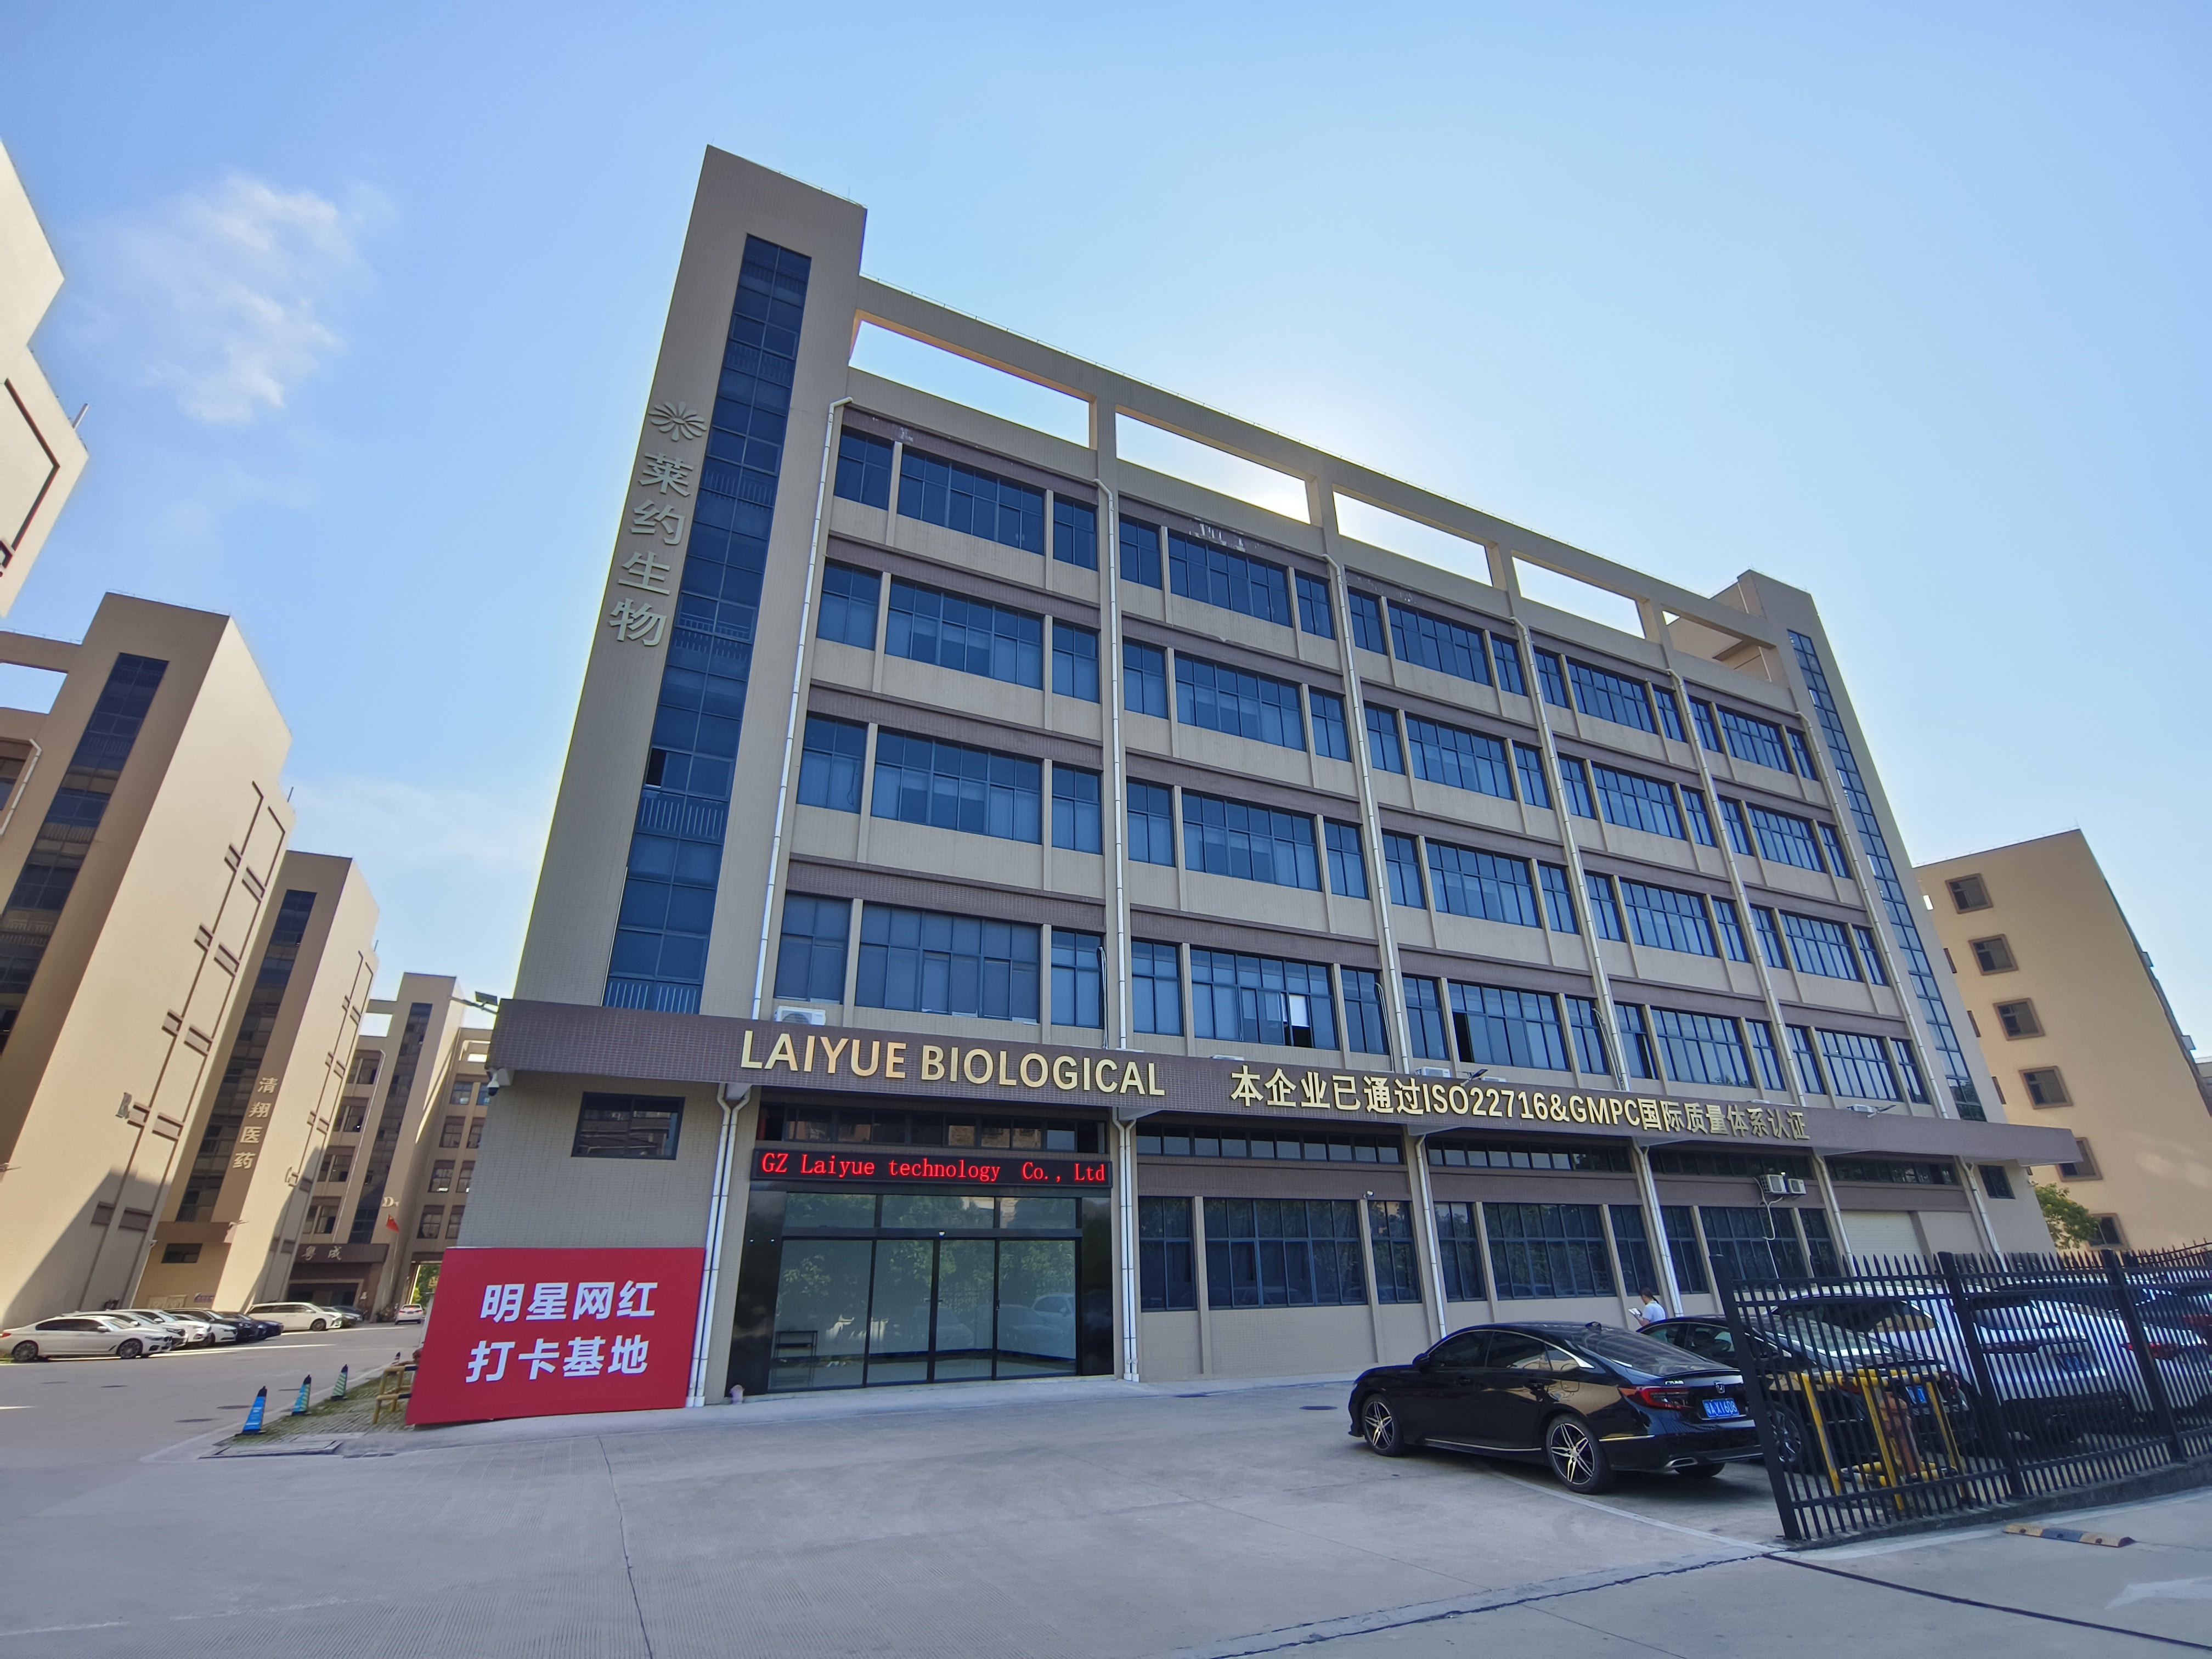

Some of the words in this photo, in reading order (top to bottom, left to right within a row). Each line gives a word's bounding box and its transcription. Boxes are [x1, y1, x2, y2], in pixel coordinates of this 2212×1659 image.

[609, 453, 694, 646] 莱约生物
[741, 1030, 906, 1079] LAIYUE
[921, 1045, 1165, 1096] BIOLOGICAL
[233, 1077, 278, 1169] 清翔医药
[1231, 1065, 1810, 1140] 本企业已通过ISO22716&GMPC国际质量体系认证
[762, 1153, 788, 1173] GZ
[801, 1154, 875, 1178] Laiyue
[889, 1158, 1001, 1182] technology
[1074, 1163, 1105, 1181] Ltd
[481, 1280, 657, 1322] 明星网红
[466, 1334, 649, 1383] 打卡基地
